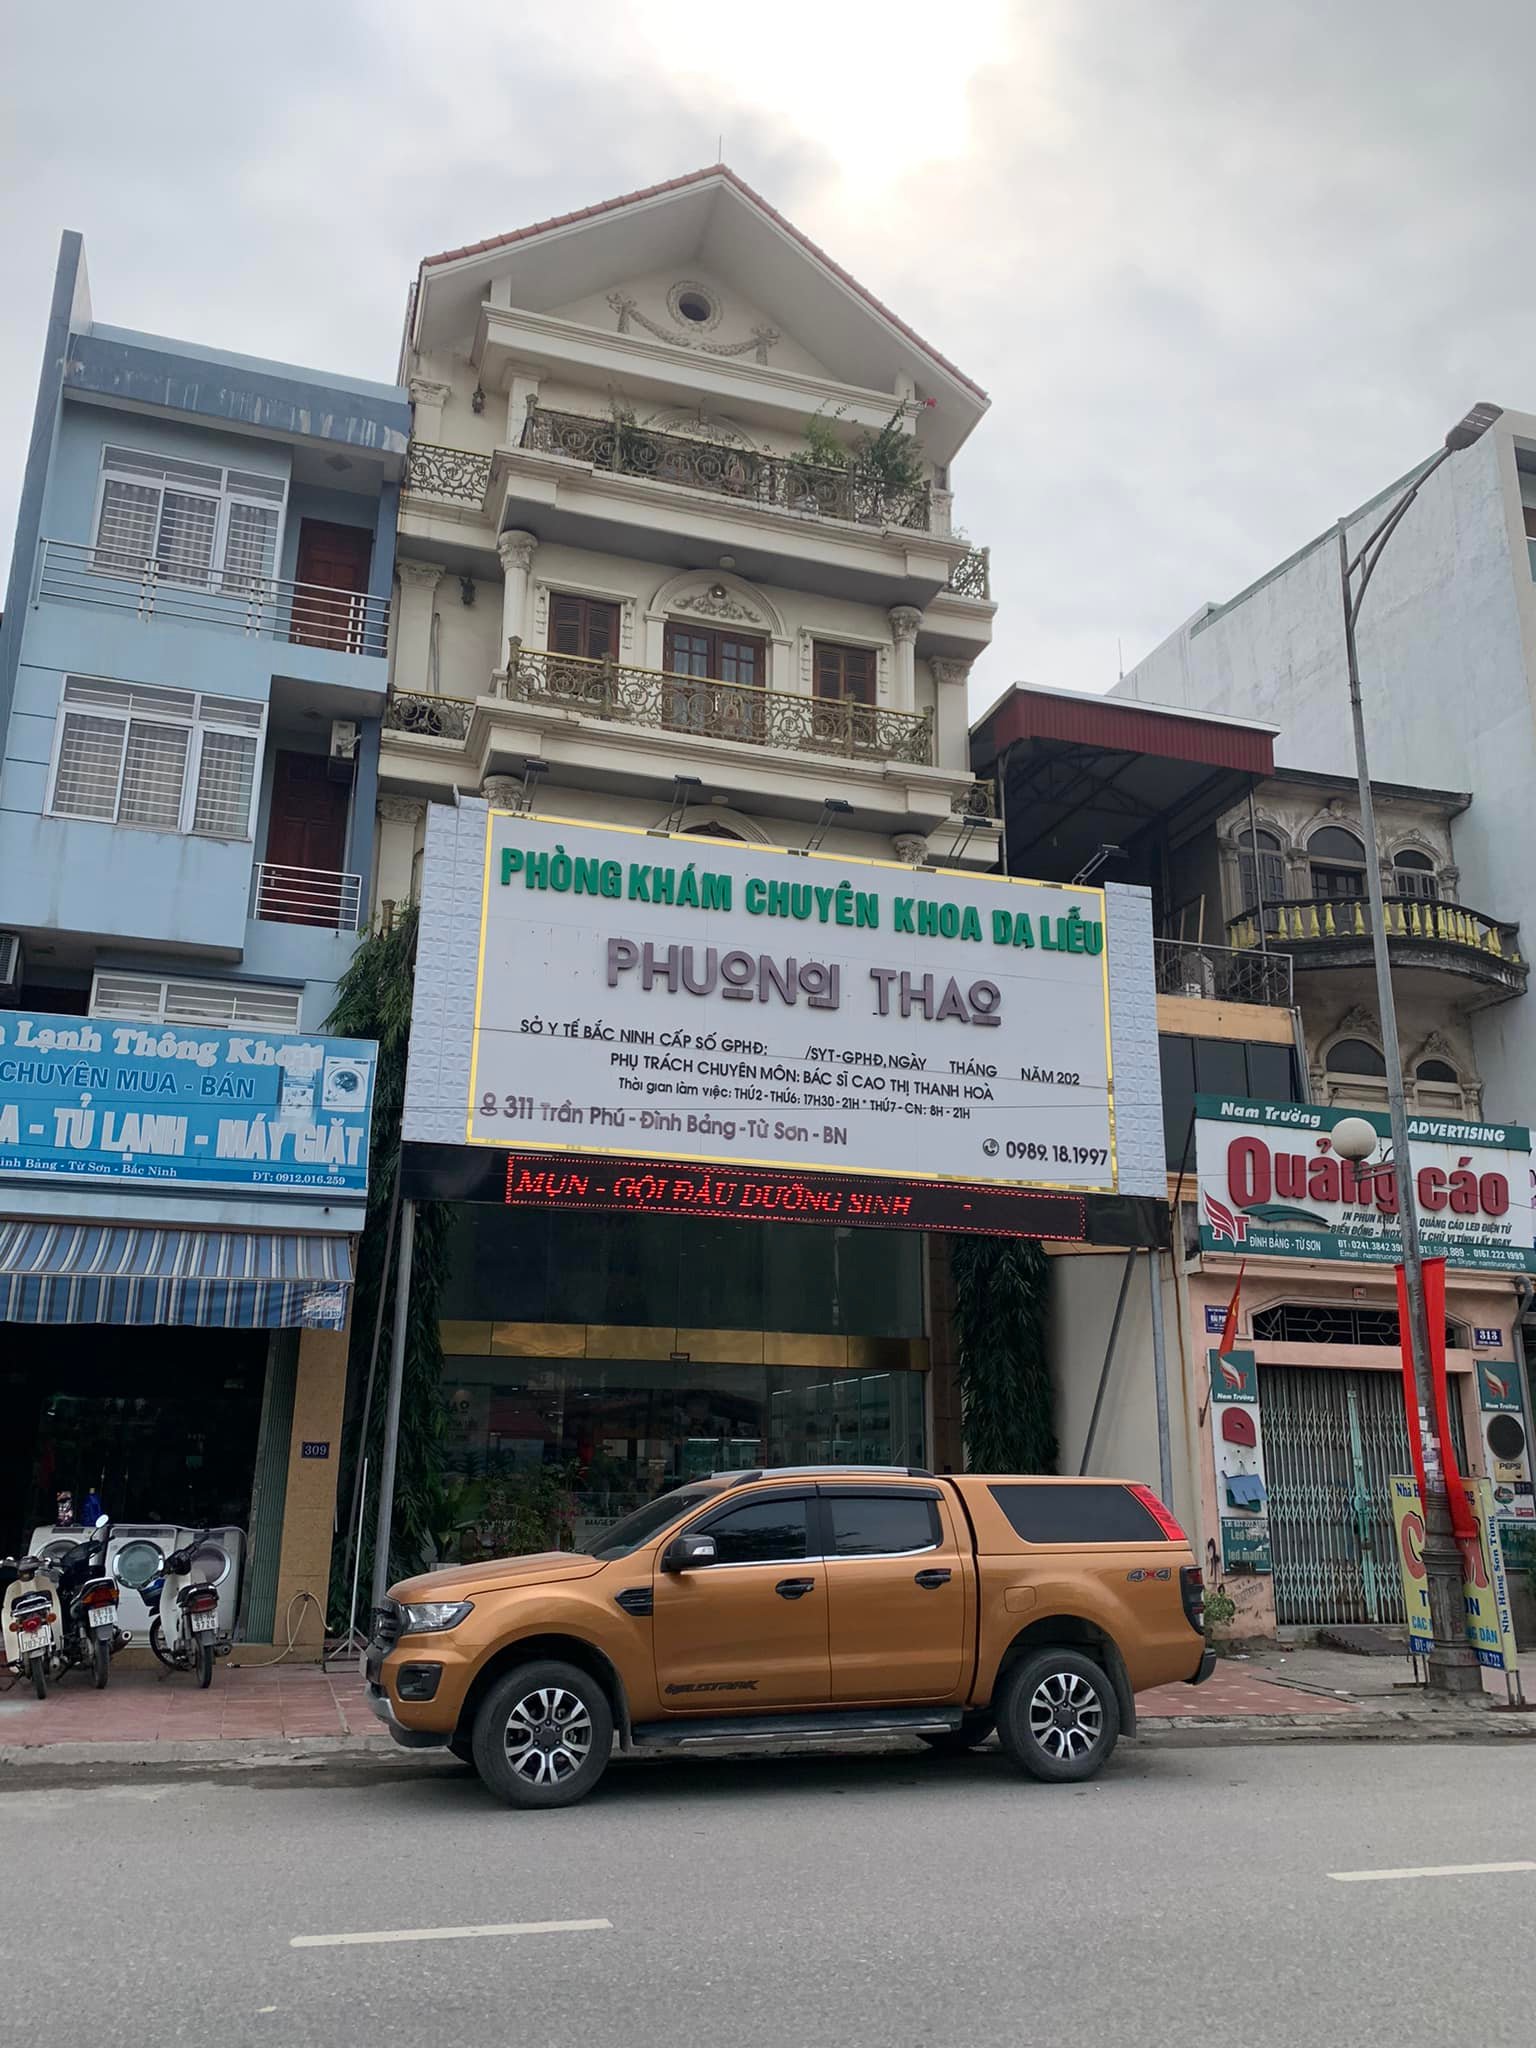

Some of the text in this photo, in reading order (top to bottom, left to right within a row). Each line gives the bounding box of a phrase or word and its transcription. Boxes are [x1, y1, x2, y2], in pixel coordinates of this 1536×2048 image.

[500, 845, 622, 898] PHÒNG
[628, 862, 732, 911] KHÁM
[745, 878, 879, 928] CHUYÊN
[894, 896, 983, 942] KHOA
[992, 909, 1035, 949] DA
[15, 1021, 102, 1054] Lạnh
[112, 1027, 220, 1067] Thông
[520, 1016, 543, 1034] SỞ
[548, 1022, 559, 1035] Y
[563, 1018, 581, 1038] TẾ
[583, 1020, 615, 1041] BẮC
[620, 1029, 654, 1045] NINH
[660, 1029, 692, 1048] CẤP
[696, 1032, 719, 1050] SỐ
[721, 1038, 768, 1056] GPHĐ:
[949, 1058, 998, 1078] THÁNG
[0, 1059, 109, 1089] CHUYÊN
[116, 1069, 178, 1094] MUA
[200, 1071, 255, 1099] BÁN
[610, 1052, 994, 1101] PHỤ TRÁCH CHUYÊN MÔN: BÁC SĨ CAO THỊ THANH HOÀ
[504, 1095, 534, 1120] 311
[540, 1100, 583, 1124] Trần
[618, 1077, 643, 1092] Thời
[646, 1082, 673, 1095] gian
[676, 1081, 698, 1096] làm
[930, 1105, 944, 1117] 8H
[953, 1107, 971, 1119] 21H
[54, 1092, 96, 1149] TỦ
[101, 1110, 189, 1161] LẠNH
[215, 1112, 288, 1161] MÁY
[1220, 1102, 1506, 1142] Nam Trường ADVERTISING
[25, 1157, 58, 1171] Bảng
[68, 1160, 85, 1171] Từ
[88, 1162, 111, 1174] Sơn
[122, 1162, 145, 1175] Bắc
[147, 1166, 177, 1177] Ninh
[1227, 1136, 1400, 1216] Quảng
[1417, 1157, 1509, 1217] cáo
[514, 1169, 590, 1197] MỤN
[847, 1192, 913, 1216] SINH
[1465, 1222, 1480, 1231] LED
[1479, 1330, 1498, 1341] 313
[304, 1444, 328, 1456] 309
